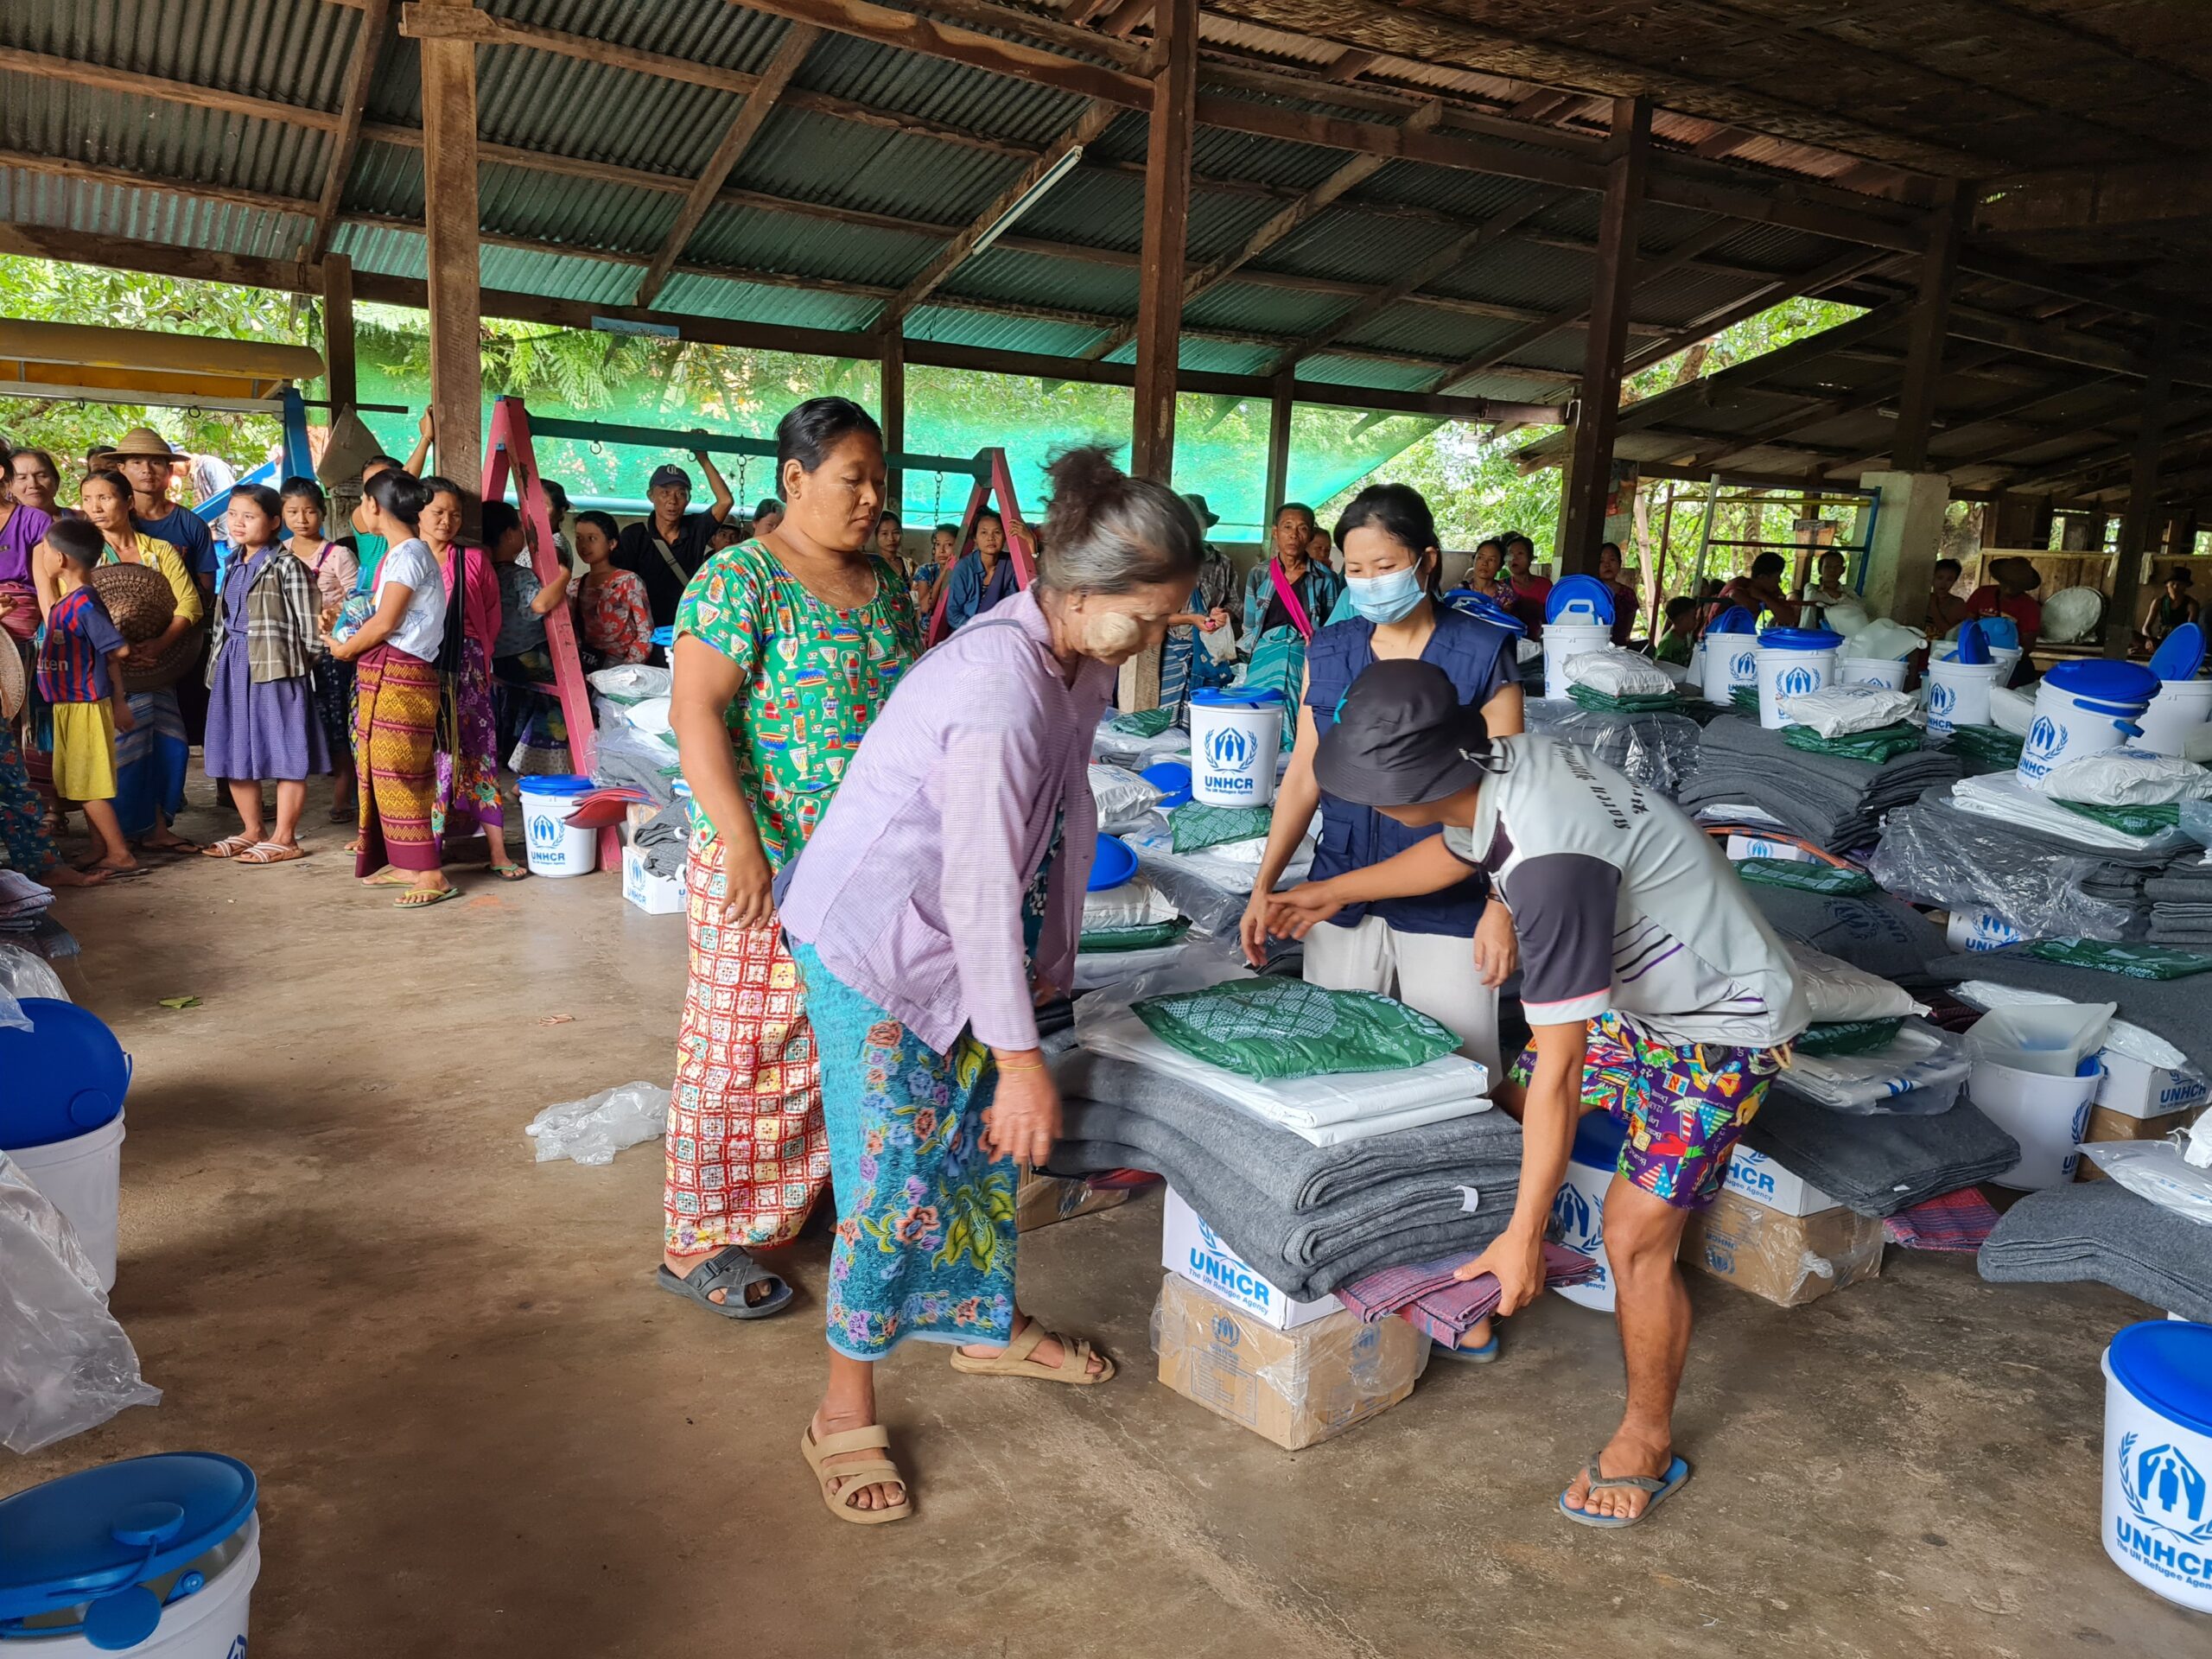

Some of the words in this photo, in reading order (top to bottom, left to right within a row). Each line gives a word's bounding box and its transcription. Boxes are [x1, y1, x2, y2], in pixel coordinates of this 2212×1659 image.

[37, 657, 69, 671] uten
[1928, 716, 1952, 729] NHCR
[1205, 775, 1253, 790] UNHCR
[1590, 785, 1632, 830] Karen
[531, 851, 566, 861] UNHCR
[627, 887, 647, 906] UNHCR
[1727, 1162, 1775, 1194] HCR
[1746, 1185, 1772, 1202] Agency
[1190, 1247, 1269, 1306] UNHCR
[1188, 1267, 1201, 1280] The
[1203, 1274, 1212, 1285] UN
[1213, 1281, 1242, 1300] Refugee
[1243, 1297, 1268, 1316] Agency
[2116, 1537, 2128, 1554] The
[2130, 1548, 2141, 1562] UN
[2143, 1556, 2183, 1581] Refugee
[2185, 1575, 2212, 1590] Agen
